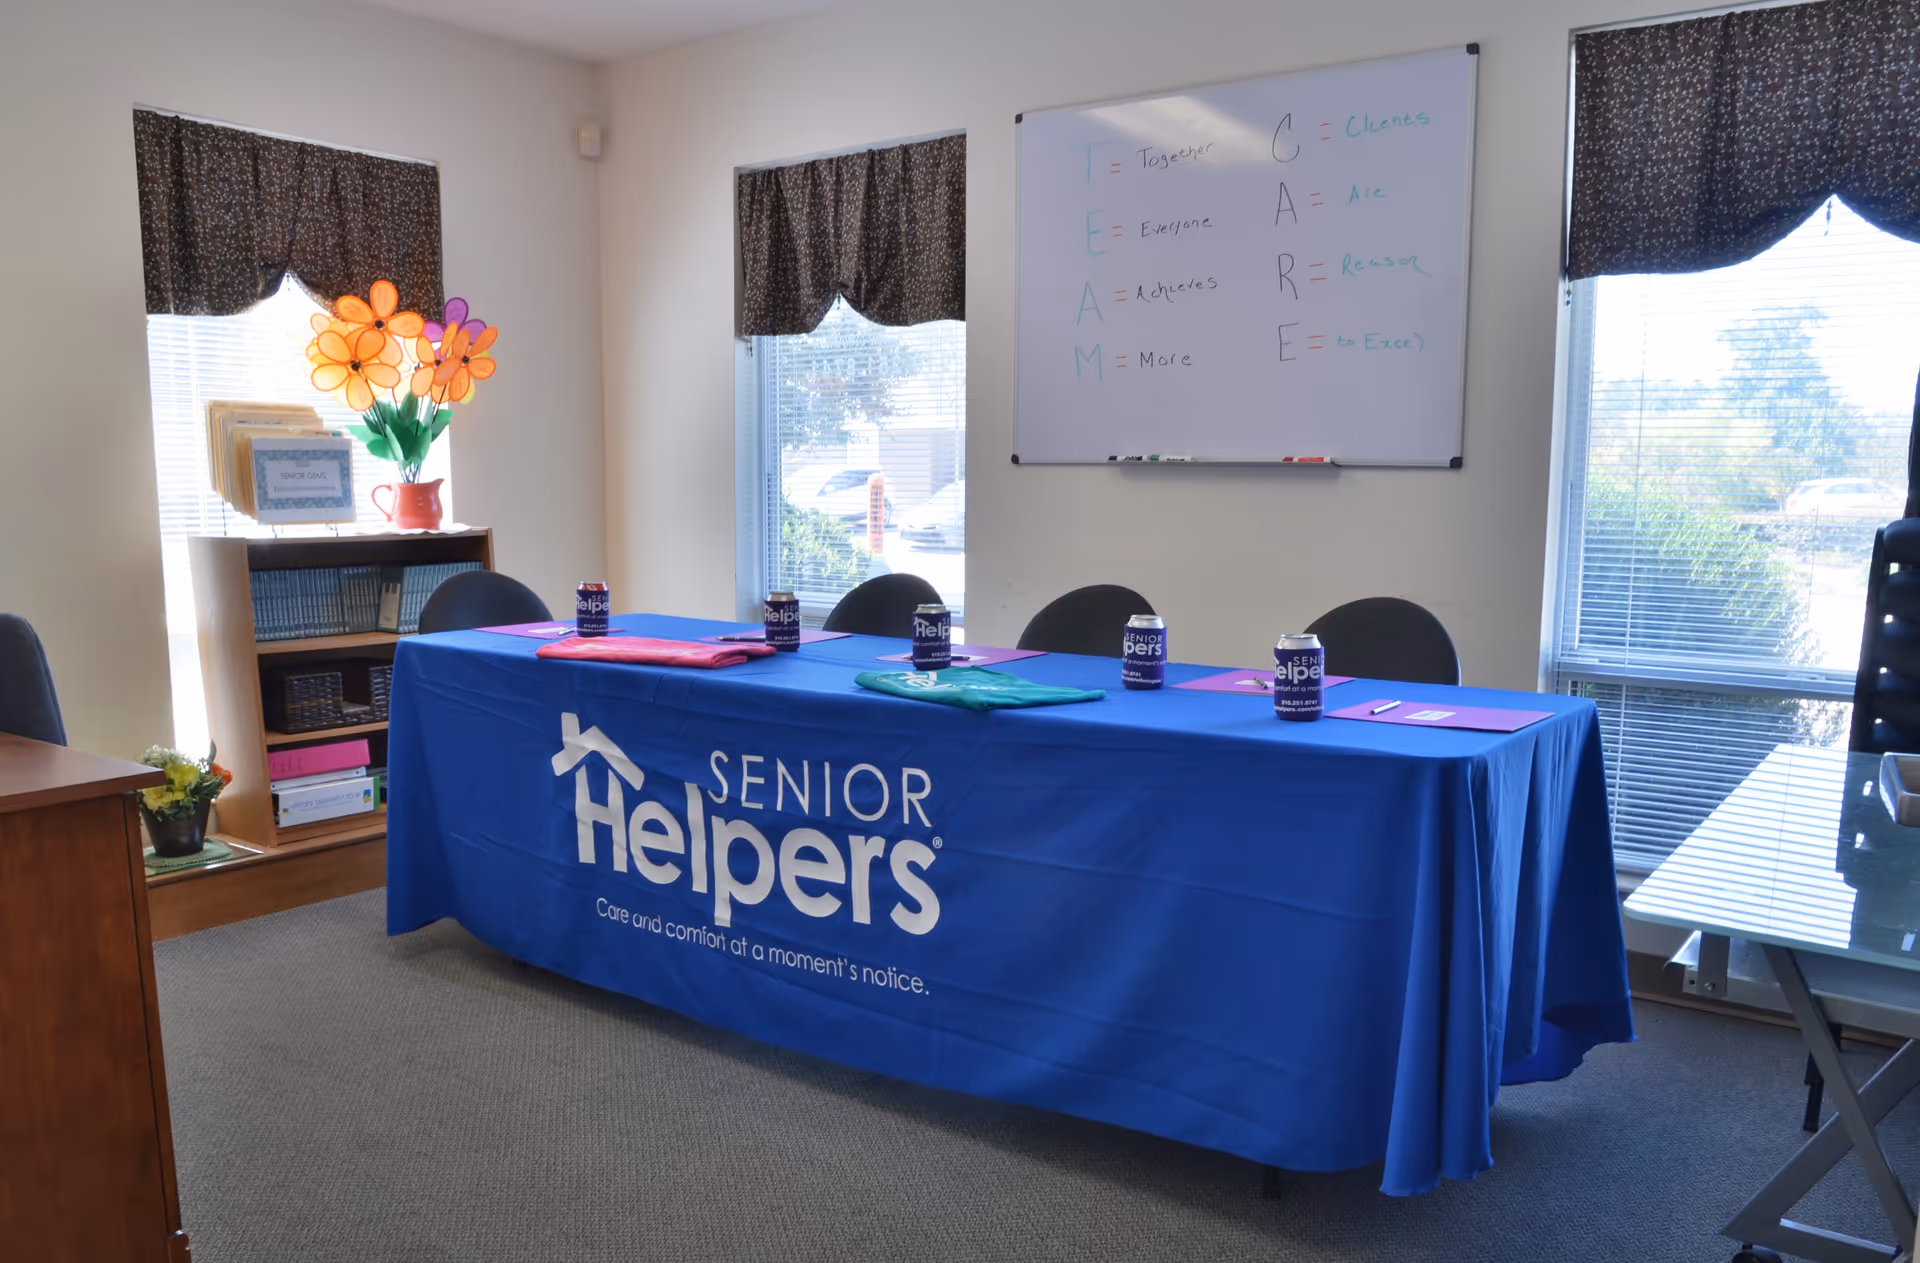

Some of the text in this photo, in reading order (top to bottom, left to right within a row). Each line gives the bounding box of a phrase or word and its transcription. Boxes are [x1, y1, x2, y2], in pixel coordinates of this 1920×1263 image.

[1136, 142, 1215, 169] Together
[1272, 113, 1300, 162] C
[1275, 182, 1297, 225] A
[1086, 209, 1106, 256] E
[1141, 217, 1213, 238] Everyone
[1278, 253, 1298, 300] R
[1076, 280, 1104, 325] A
[1136, 277, 1218, 303] Achieves
[1075, 343, 1103, 382] M
[1140, 351, 1192, 368] More
[1278, 322, 1300, 361] E
[1337, 335, 1355, 347] to
[1126, 632, 1163, 644] SENIOR
[707, 750, 932, 828] SENIOR
[596, 897, 930, 995] Care and comfort at a moment's notice.
